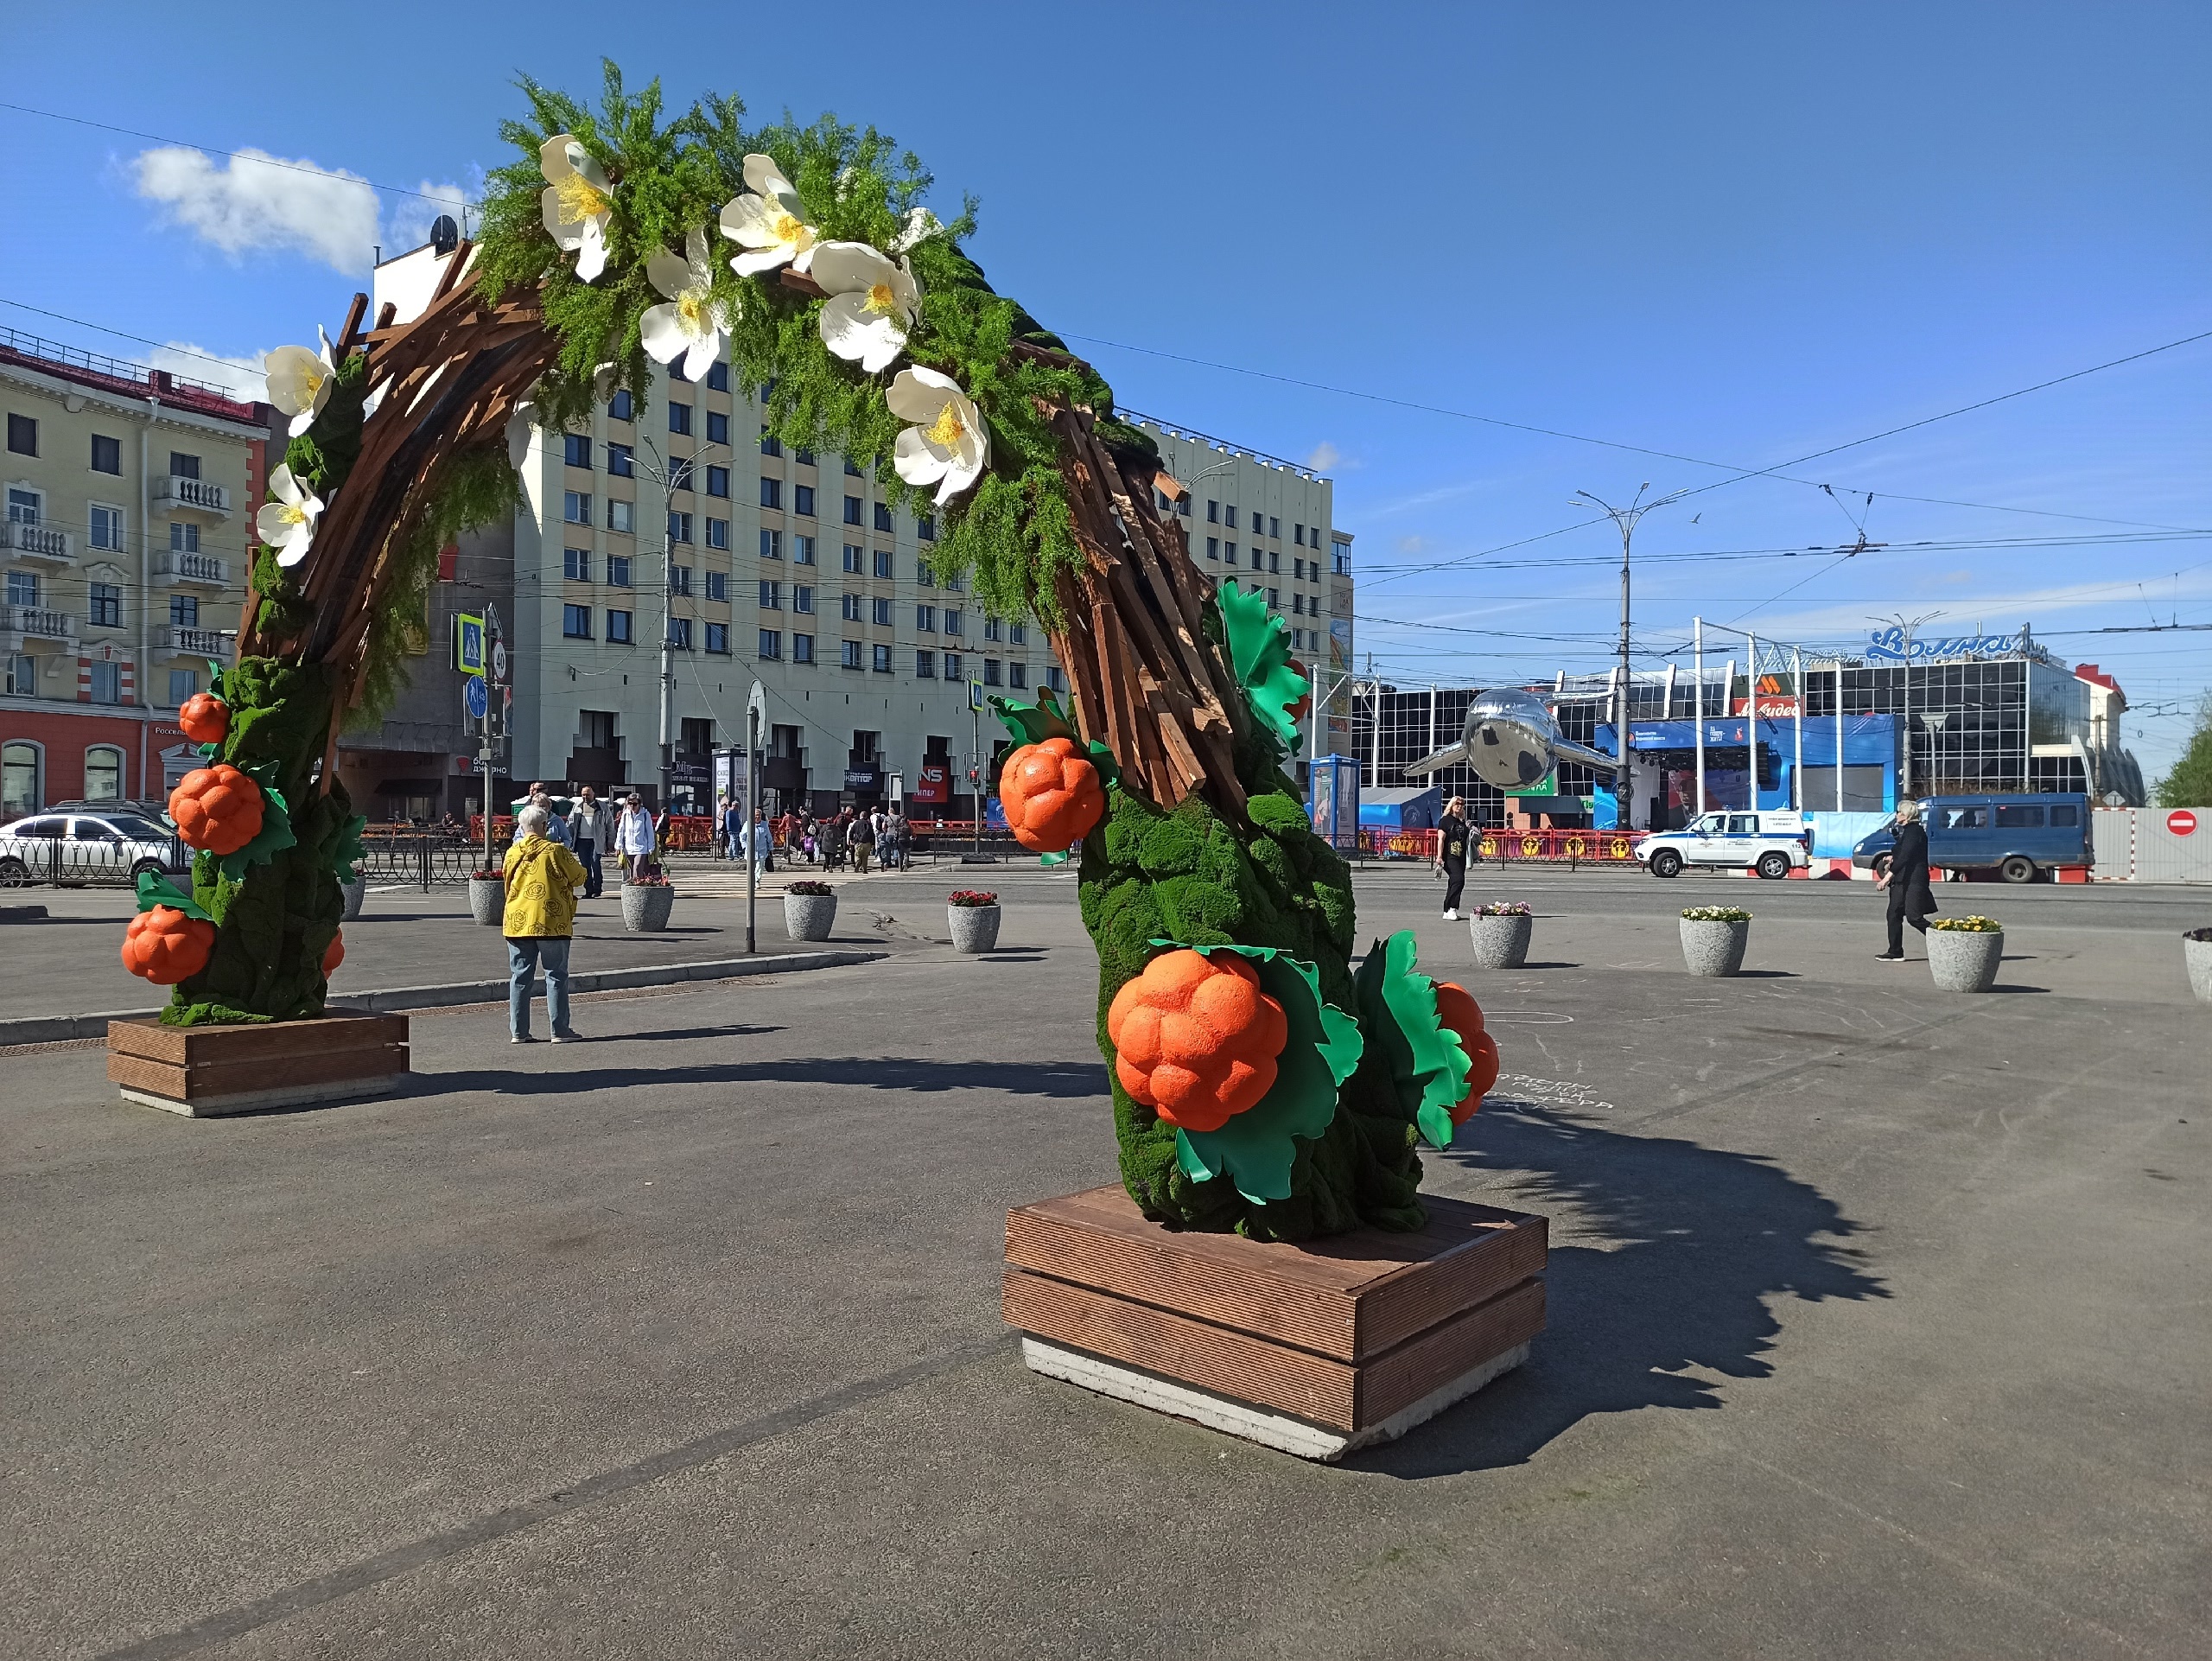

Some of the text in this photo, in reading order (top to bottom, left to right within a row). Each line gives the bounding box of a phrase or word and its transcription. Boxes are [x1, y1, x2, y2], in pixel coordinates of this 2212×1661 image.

[497, 652, 505, 670] 40
[155, 727, 188, 735] Россель
[473, 766, 507, 774] джрно
[918, 768, 943, 782] NS
